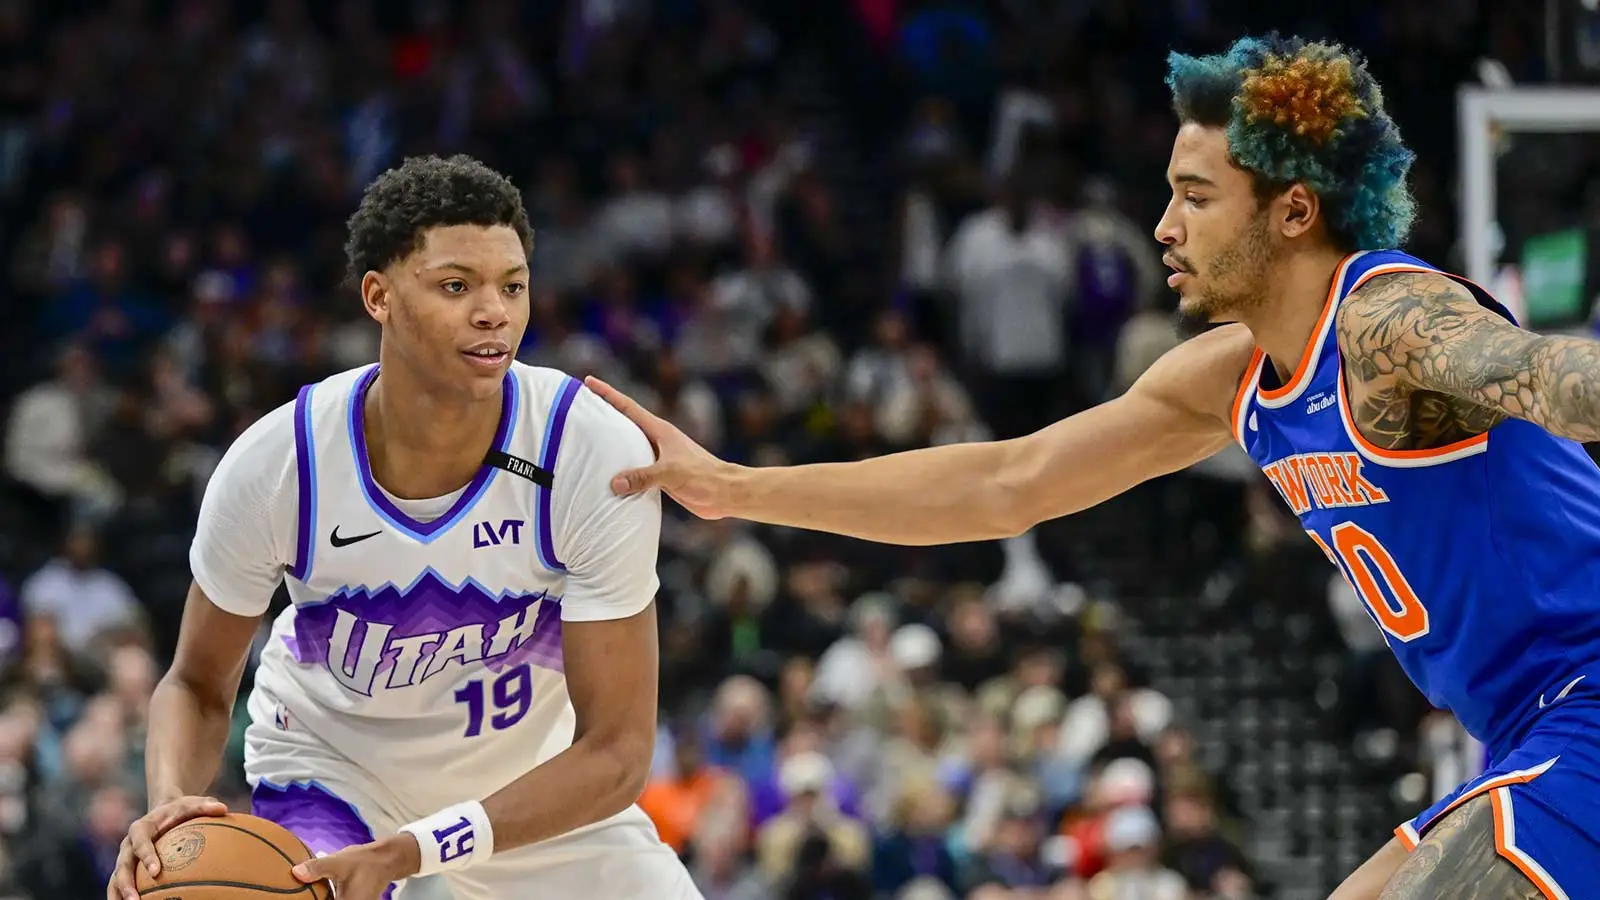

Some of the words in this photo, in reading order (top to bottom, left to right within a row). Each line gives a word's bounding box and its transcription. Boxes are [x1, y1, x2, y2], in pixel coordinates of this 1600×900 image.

[506, 457, 535, 479] FRANK
[473, 519, 525, 549] LVT
[326, 588, 548, 697] UTAH
[454, 661, 532, 737] 19
[432, 816, 474, 863] 19
